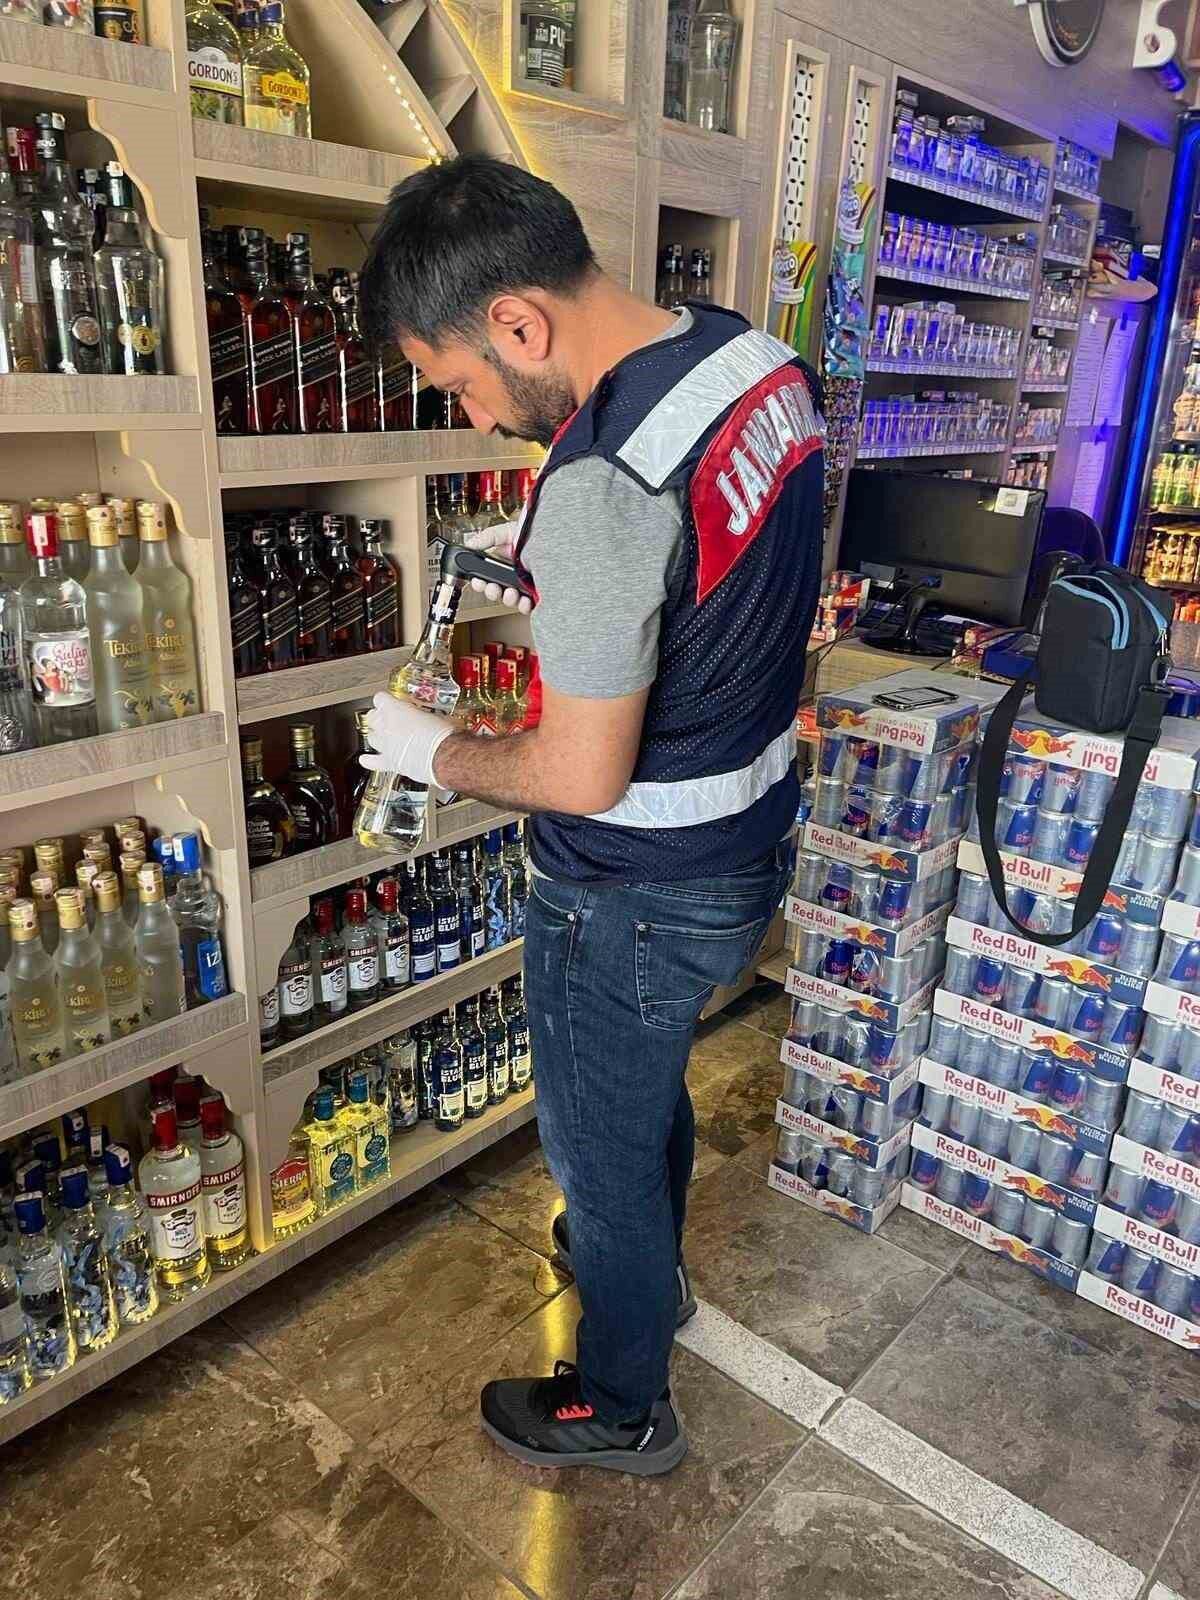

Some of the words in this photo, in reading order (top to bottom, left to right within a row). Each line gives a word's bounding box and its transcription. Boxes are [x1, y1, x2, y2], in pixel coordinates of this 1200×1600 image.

[875, 721, 899, 741] Bull
[899, 725, 925, 748] Red
[1082, 750, 1119, 774] Bull
[811, 829, 833, 845] Red
[834, 836, 857, 851] Bull
[1019, 859, 1052, 883] Bull
[792, 904, 814, 920] Red
[815, 910, 837, 928] Bull
[972, 928, 1004, 950] Red
[1006, 938, 1038, 961] Bull
[793, 975, 815, 991] Red
[816, 982, 838, 998] Bull
[959, 1000, 991, 1021] Red
[992, 1009, 1024, 1034] Bull
[1178, 995, 1200, 1015] Re
[788, 1046, 810, 1061] Red
[810, 1053, 832, 1072] Bull
[944, 1069, 975, 1092] Red
[976, 1081, 1006, 1105] Bull
[1161, 1073, 1199, 1099] Red
[782, 1107, 803, 1124] Red
[803, 1116, 824, 1134] Bull
[936, 1136, 966, 1158] Red
[967, 1149, 996, 1172] Bull
[203, 1166, 241, 1186] SMIRNO
[775, 1172, 796, 1189] Red
[1143, 1150, 1180, 1177] Red
[1181, 1166, 1200, 1188] Bu
[150, 1182, 201, 1207] SMIRNOFF
[924, 1196, 953, 1218] Red
[954, 1209, 982, 1234] Bull
[1125, 1220, 1161, 1245] Red
[1162, 1237, 1198, 1263] Bull
[1106, 1286, 1140, 1313] Red
[1141, 1305, 1176, 1330] Bull
